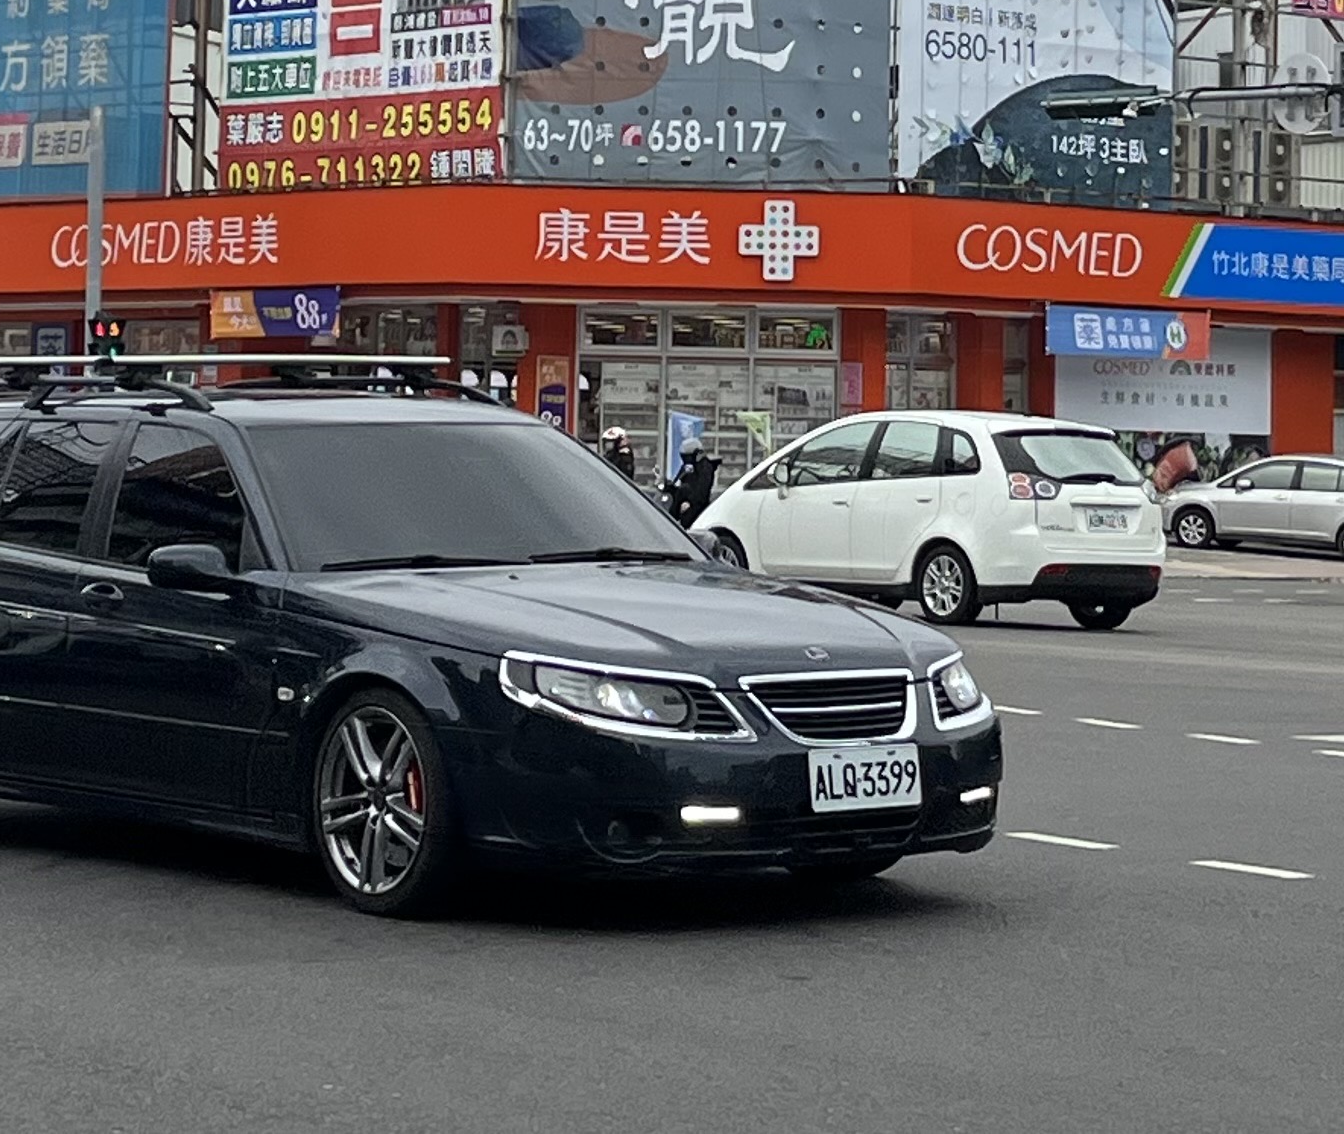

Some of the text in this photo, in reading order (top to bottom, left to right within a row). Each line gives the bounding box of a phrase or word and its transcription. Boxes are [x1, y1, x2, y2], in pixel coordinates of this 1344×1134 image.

[925, 29, 1038, 66] 6580-111
[292, 98, 493, 143] 0911-255554
[523, 119, 787, 153] 63~70坪 658-1177
[1051, 133, 1096, 160] 142坪
[227, 152, 423, 190] 0976-711322
[50, 213, 279, 268] COSMED 康是美
[534, 208, 712, 266] 康是美
[957, 224, 1143, 278] COSMED
[1092, 359, 1151, 376] COSMED
